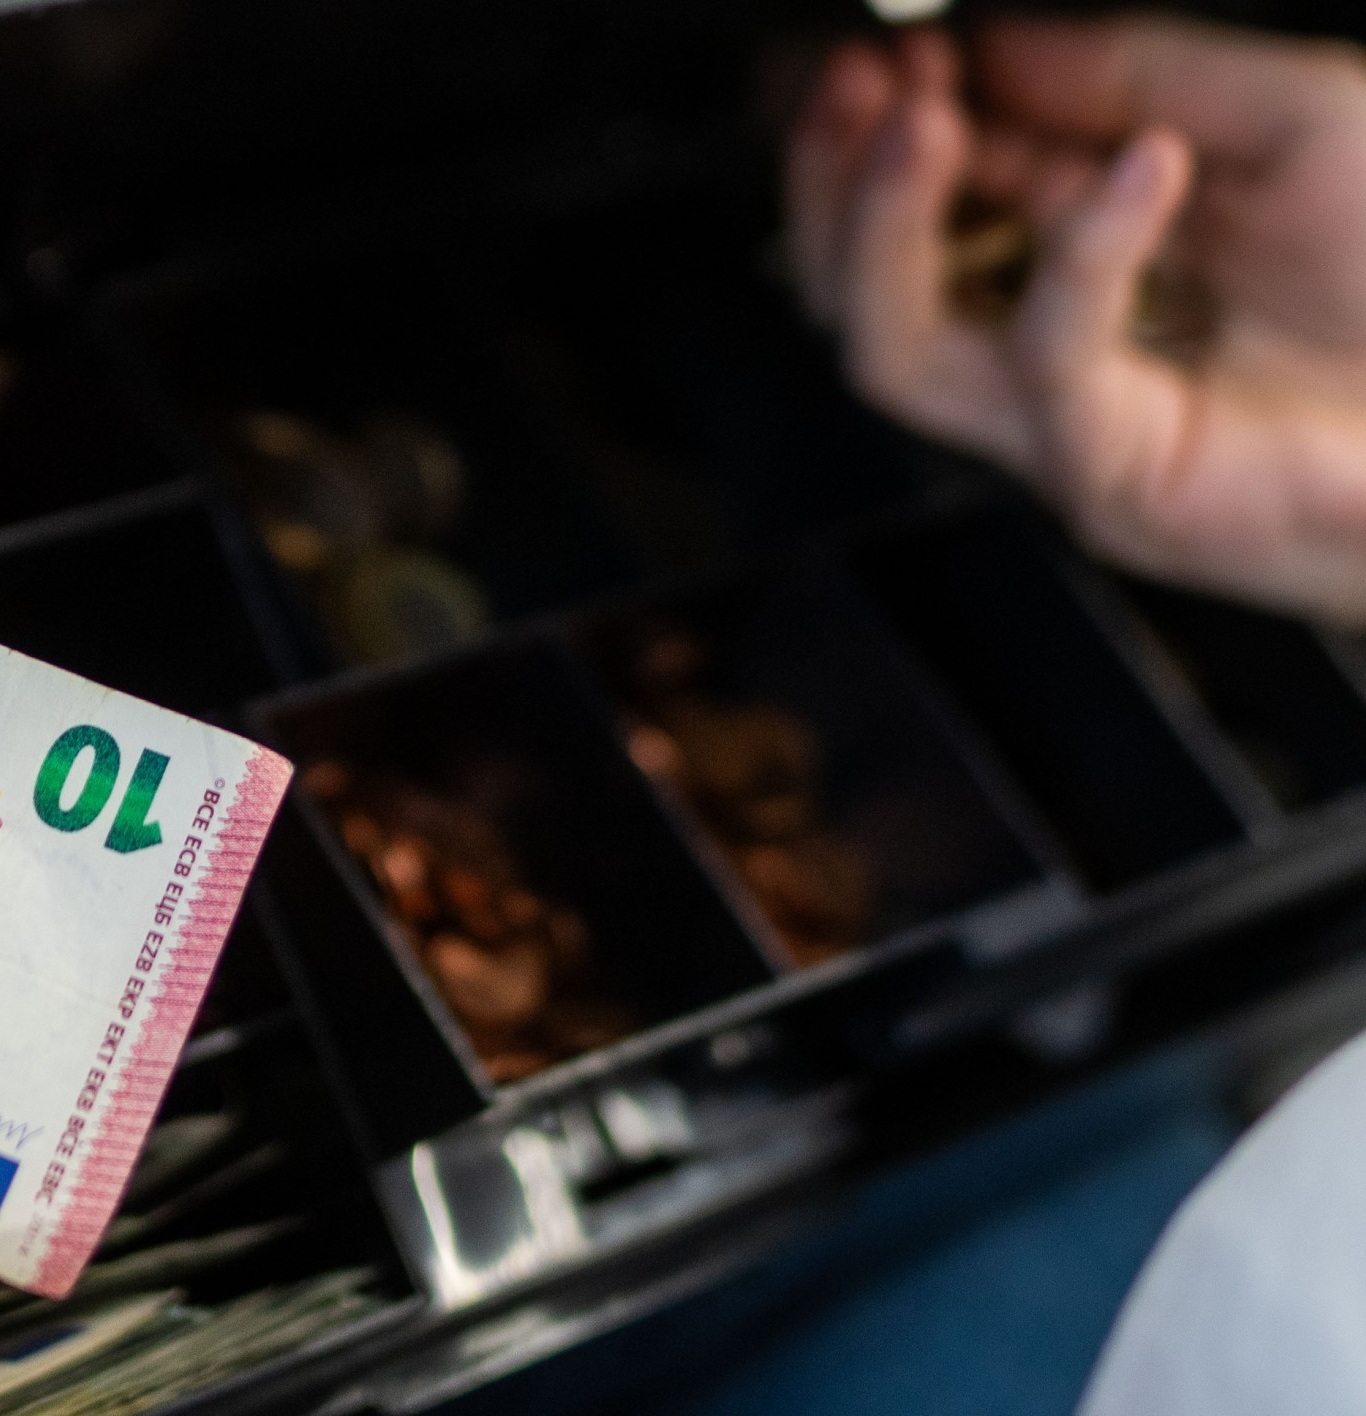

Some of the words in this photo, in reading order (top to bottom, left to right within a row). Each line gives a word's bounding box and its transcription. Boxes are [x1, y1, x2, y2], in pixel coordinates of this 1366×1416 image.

[33, 724, 171, 855] 10
[174, 834, 202, 877] ECB
[135, 929, 164, 972] EZB
[118, 975, 145, 1019] EKP
[97, 1021, 125, 1065] EKT
[76, 1067, 106, 1111] EKB
